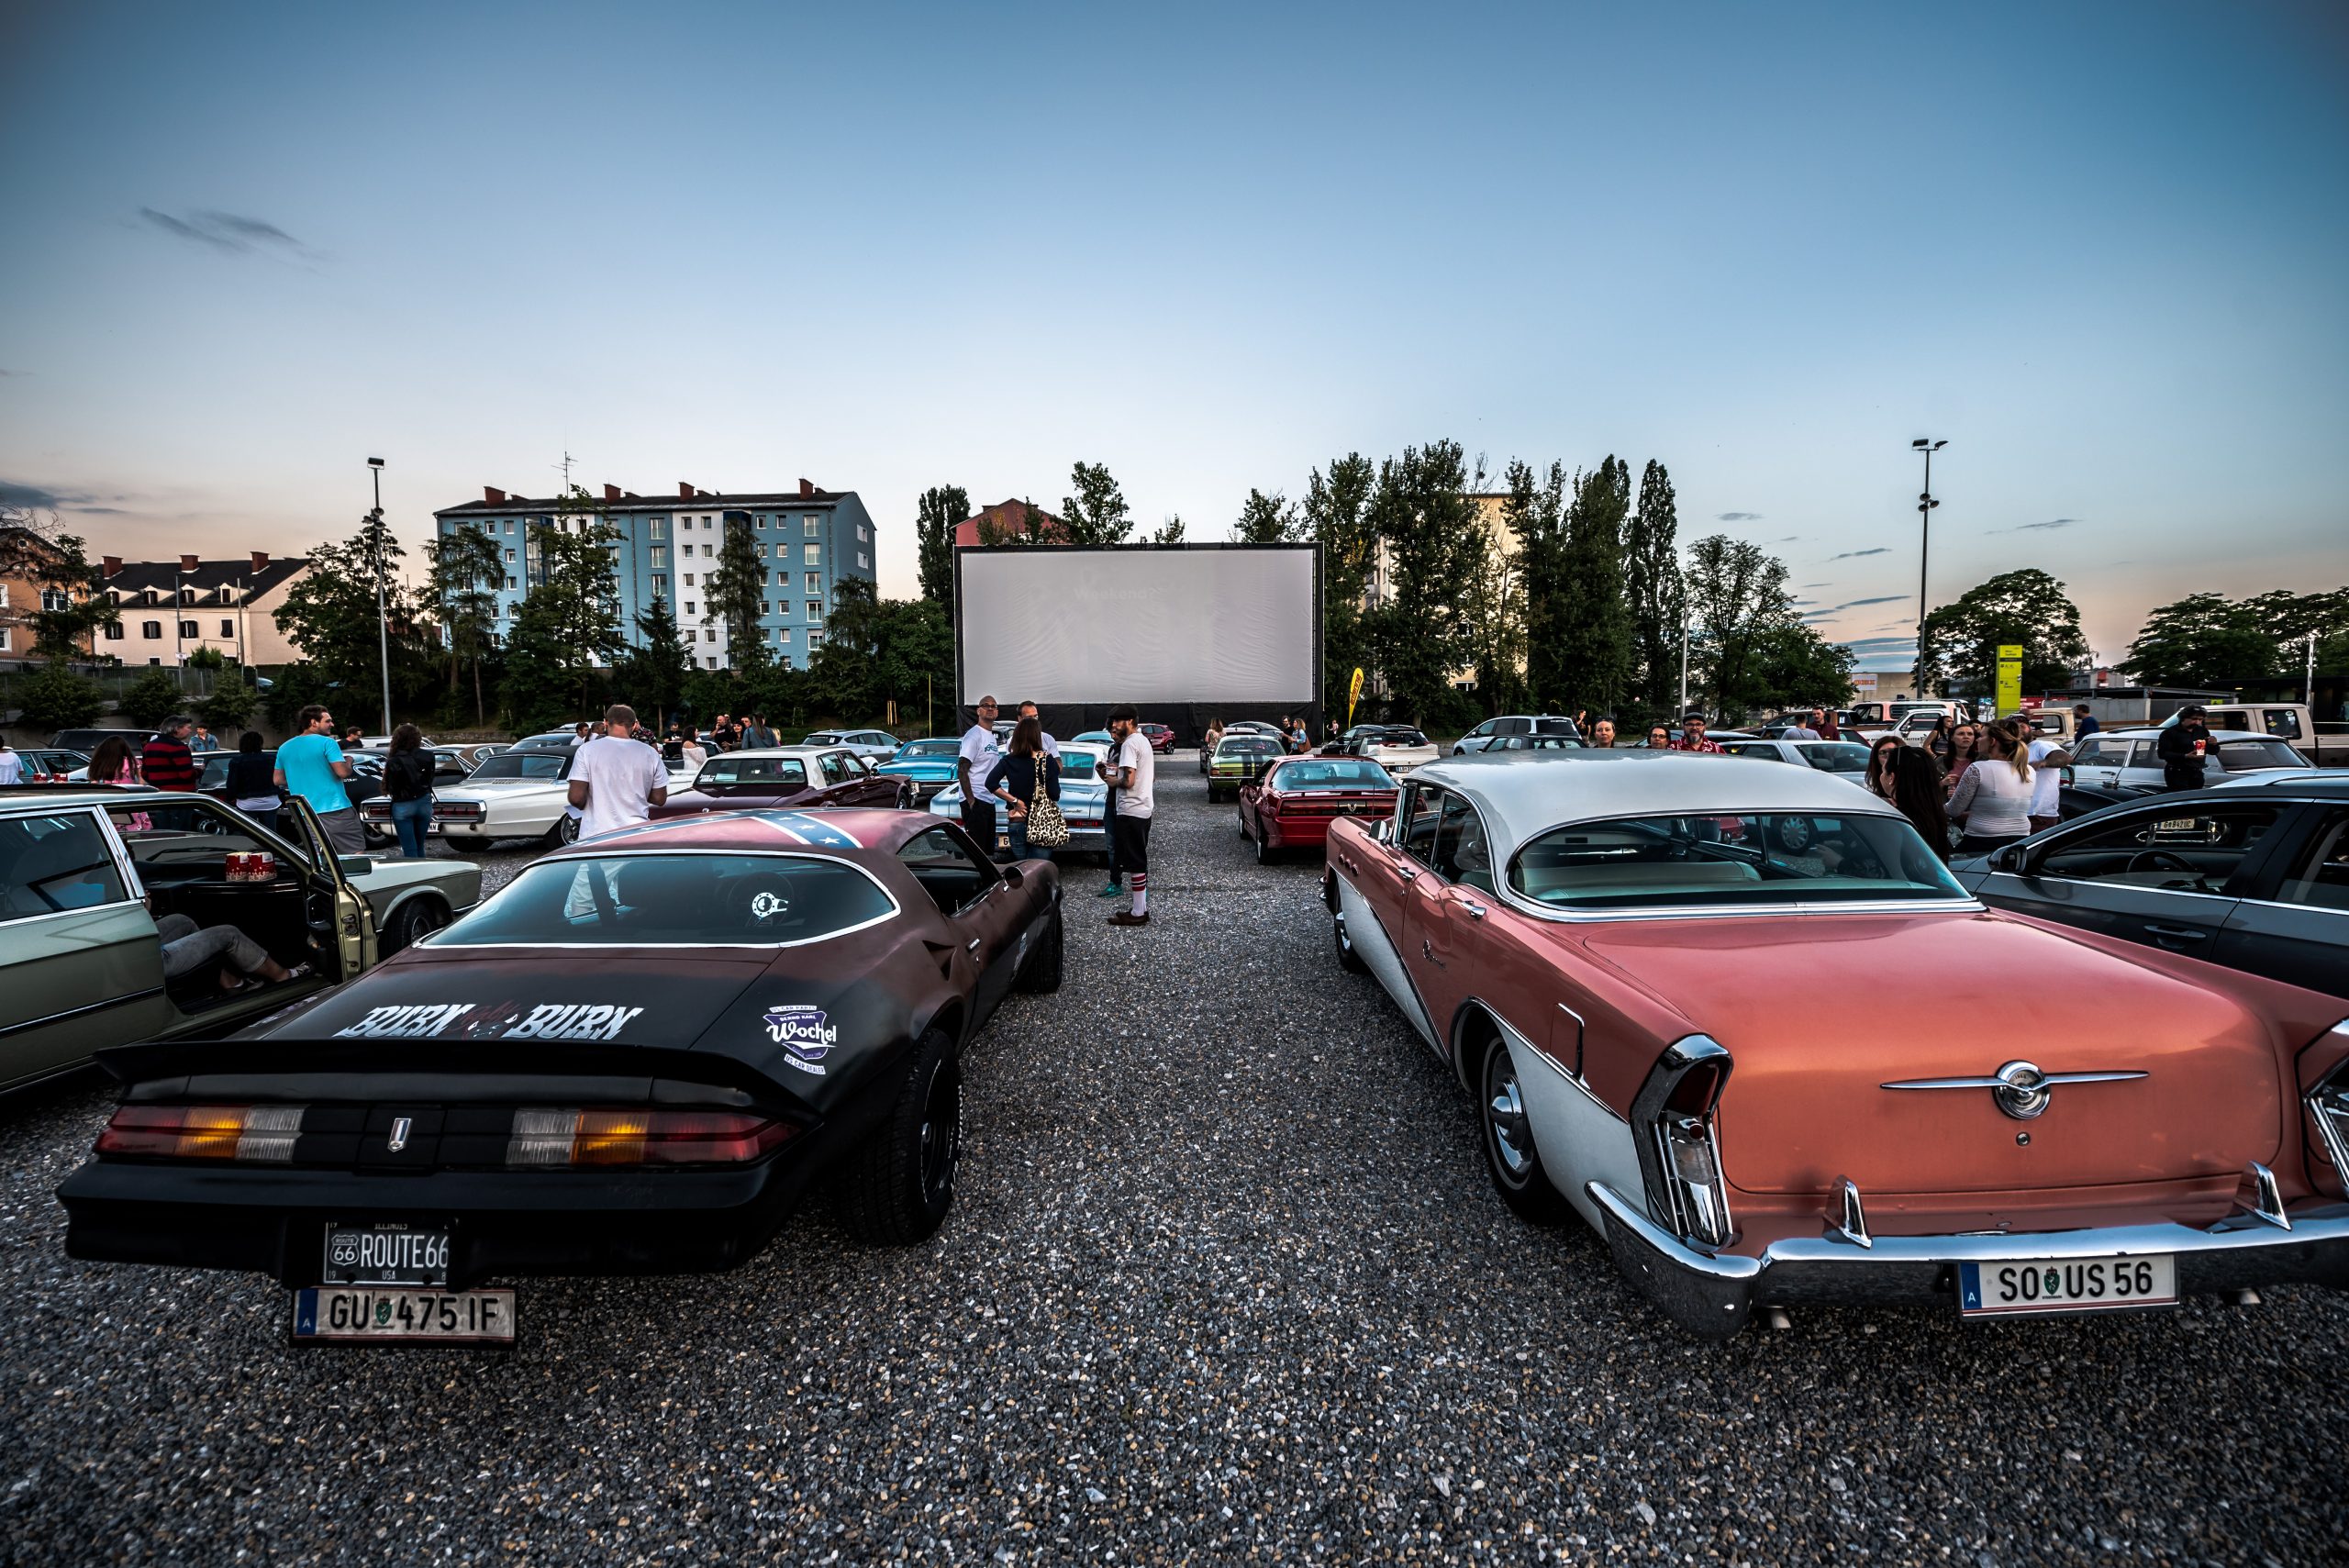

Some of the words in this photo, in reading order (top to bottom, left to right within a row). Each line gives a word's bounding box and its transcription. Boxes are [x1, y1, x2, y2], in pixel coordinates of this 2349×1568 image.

[332, 1003, 477, 1038] BURN
[501, 1004, 644, 1040] BURN
[766, 1021, 837, 1045] Wochel
[334, 1246, 355, 1262] 66
[382, 1270, 396, 1280] USA
[1998, 1266, 2040, 1301] SO
[2065, 1263, 2106, 1298] US
[2114, 1261, 2153, 1296] 56
[1967, 1292, 1976, 1303] A
[329, 1294, 371, 1330] GU
[302, 1317, 311, 1329] A
